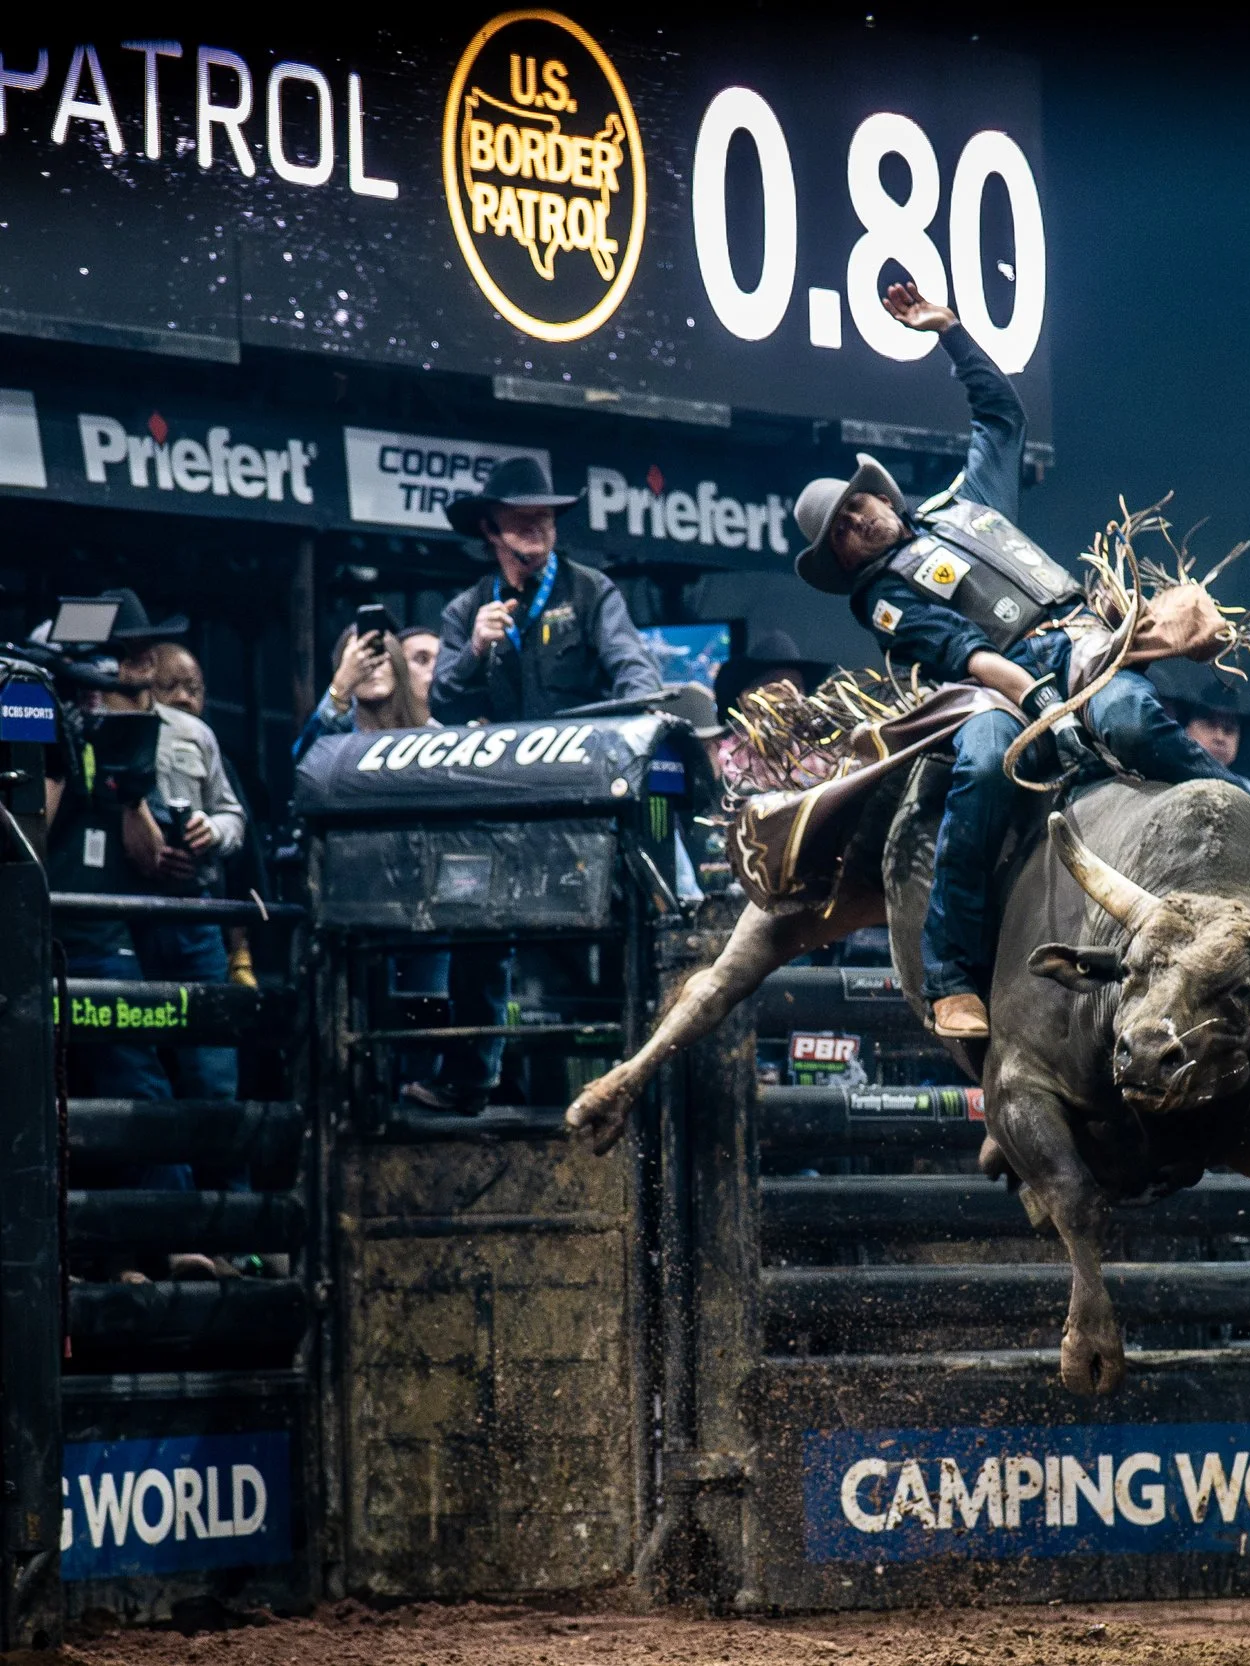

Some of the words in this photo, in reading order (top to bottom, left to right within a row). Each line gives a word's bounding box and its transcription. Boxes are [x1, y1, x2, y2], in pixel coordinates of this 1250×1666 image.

[509, 53, 578, 114] U.S.
[470, 119, 620, 193] BORDER
[471, 181, 619, 254] PATROL
[692, 86, 1046, 375] 0.80
[78, 411, 314, 505] Priefert
[379, 445, 495, 483] COOPE
[398, 482, 475, 513] TIR
[587, 464, 789, 555] Priefert
[357, 727, 518, 772] LUCAS
[71, 998, 112, 1026] the
[116, 985, 188, 1028] Beast!
[792, 1036, 856, 1062] PBR
[78, 1464, 268, 1548] WORLD
[841, 1453, 1166, 1532] CAMPING
